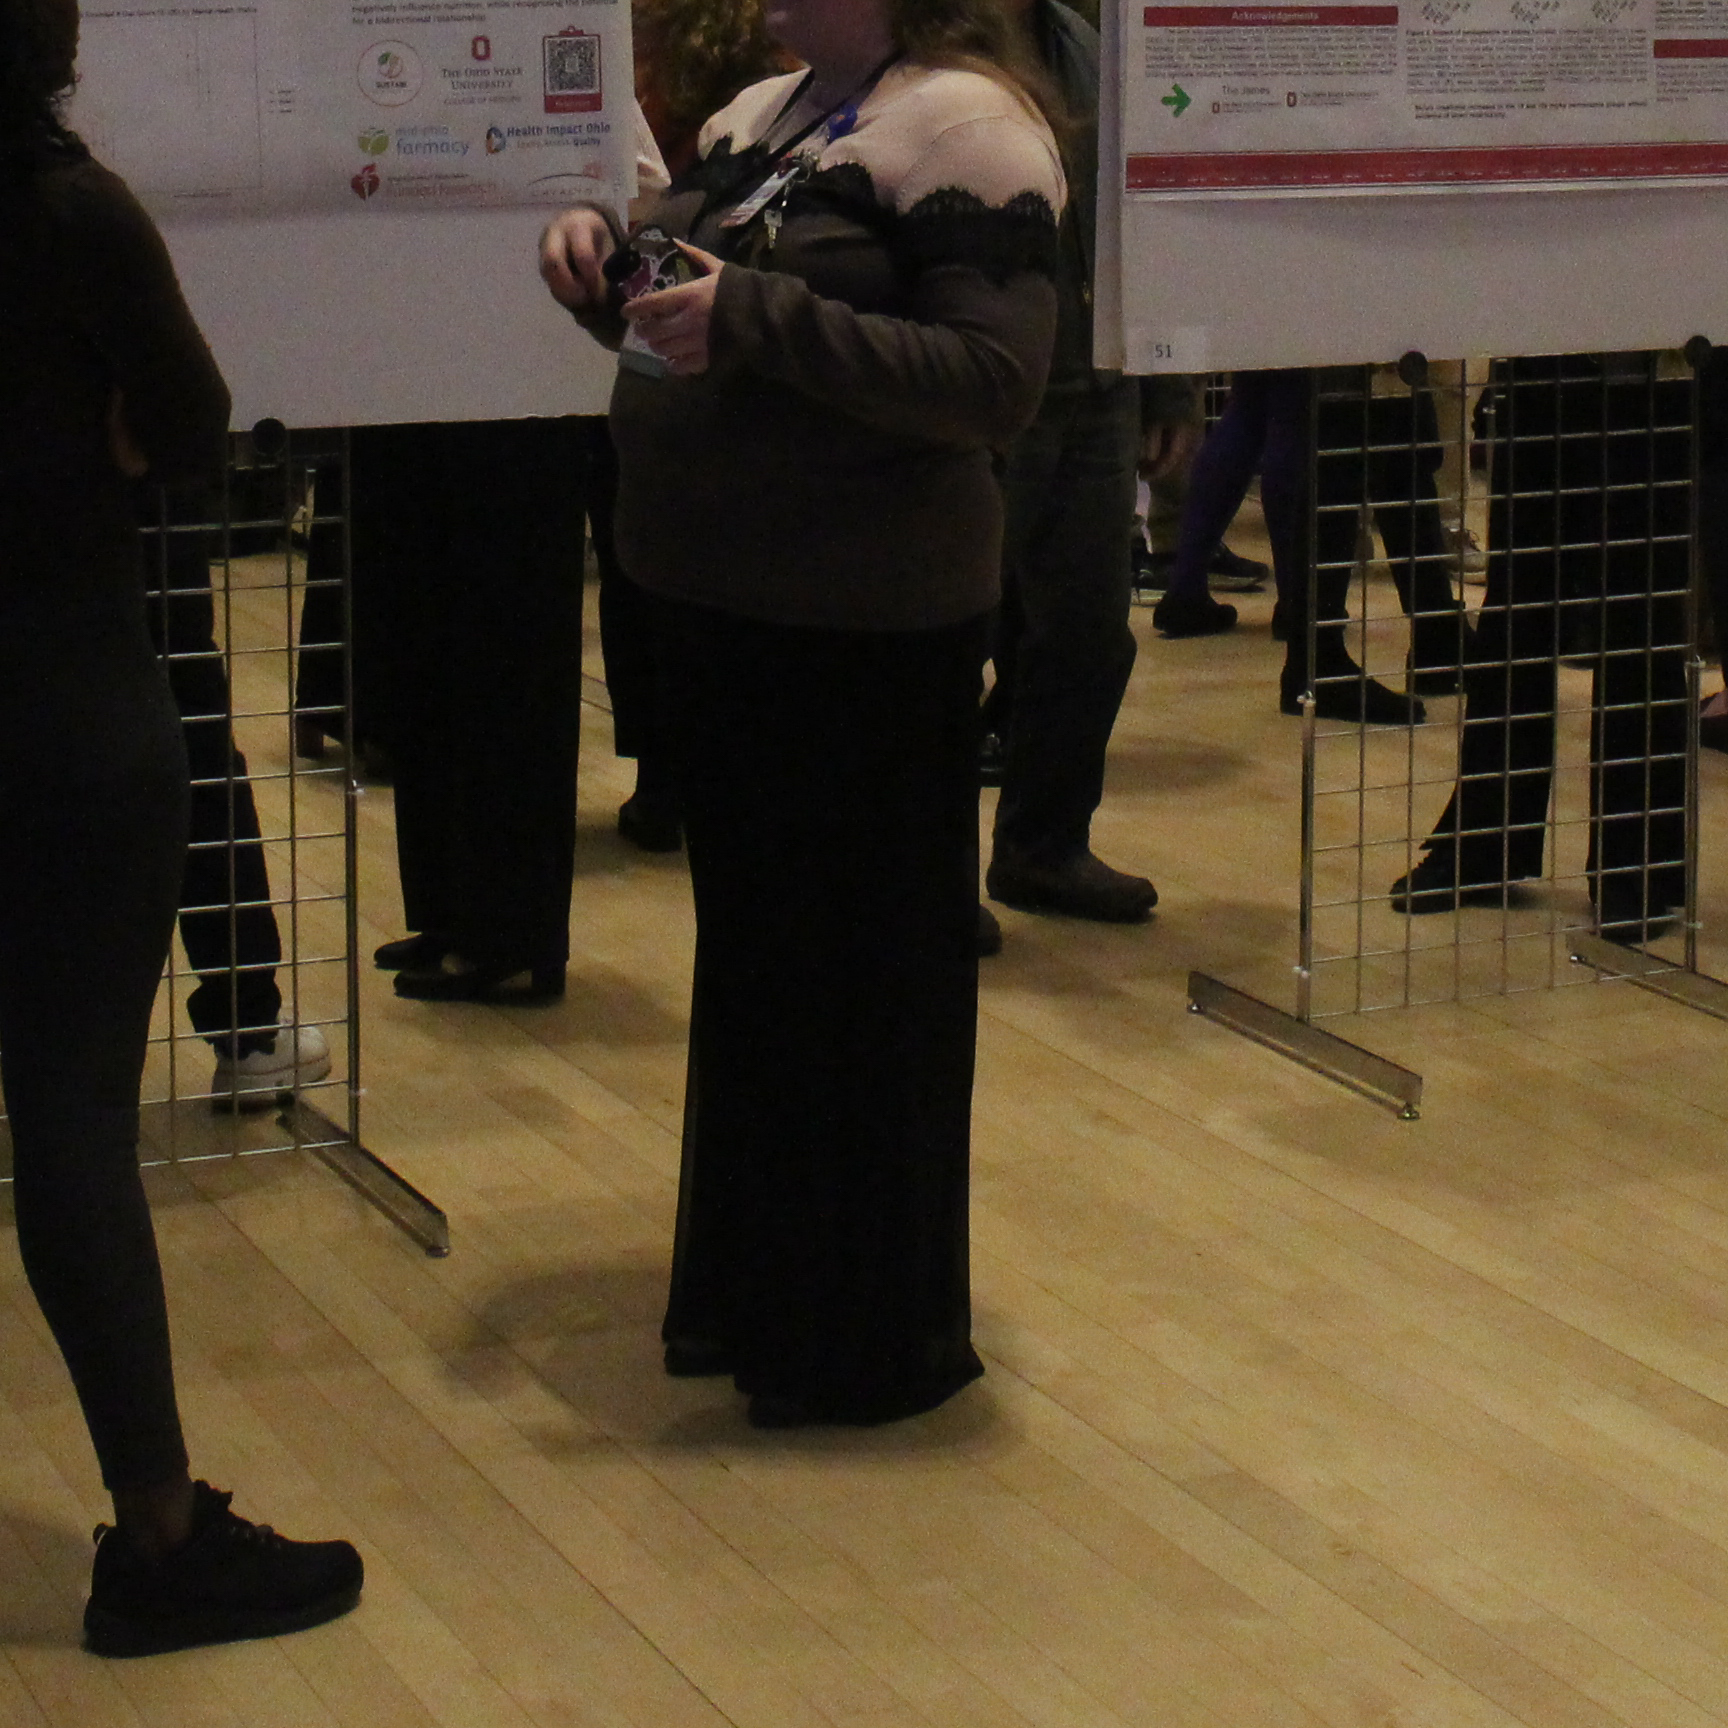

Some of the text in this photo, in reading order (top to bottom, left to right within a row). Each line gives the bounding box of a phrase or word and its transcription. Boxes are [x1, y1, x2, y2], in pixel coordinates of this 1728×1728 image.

[507, 126, 543, 137] Health
[546, 124, 583, 138] Impact
[396, 138, 469, 156] farmacy
[1155, 344, 1172, 358] 51
